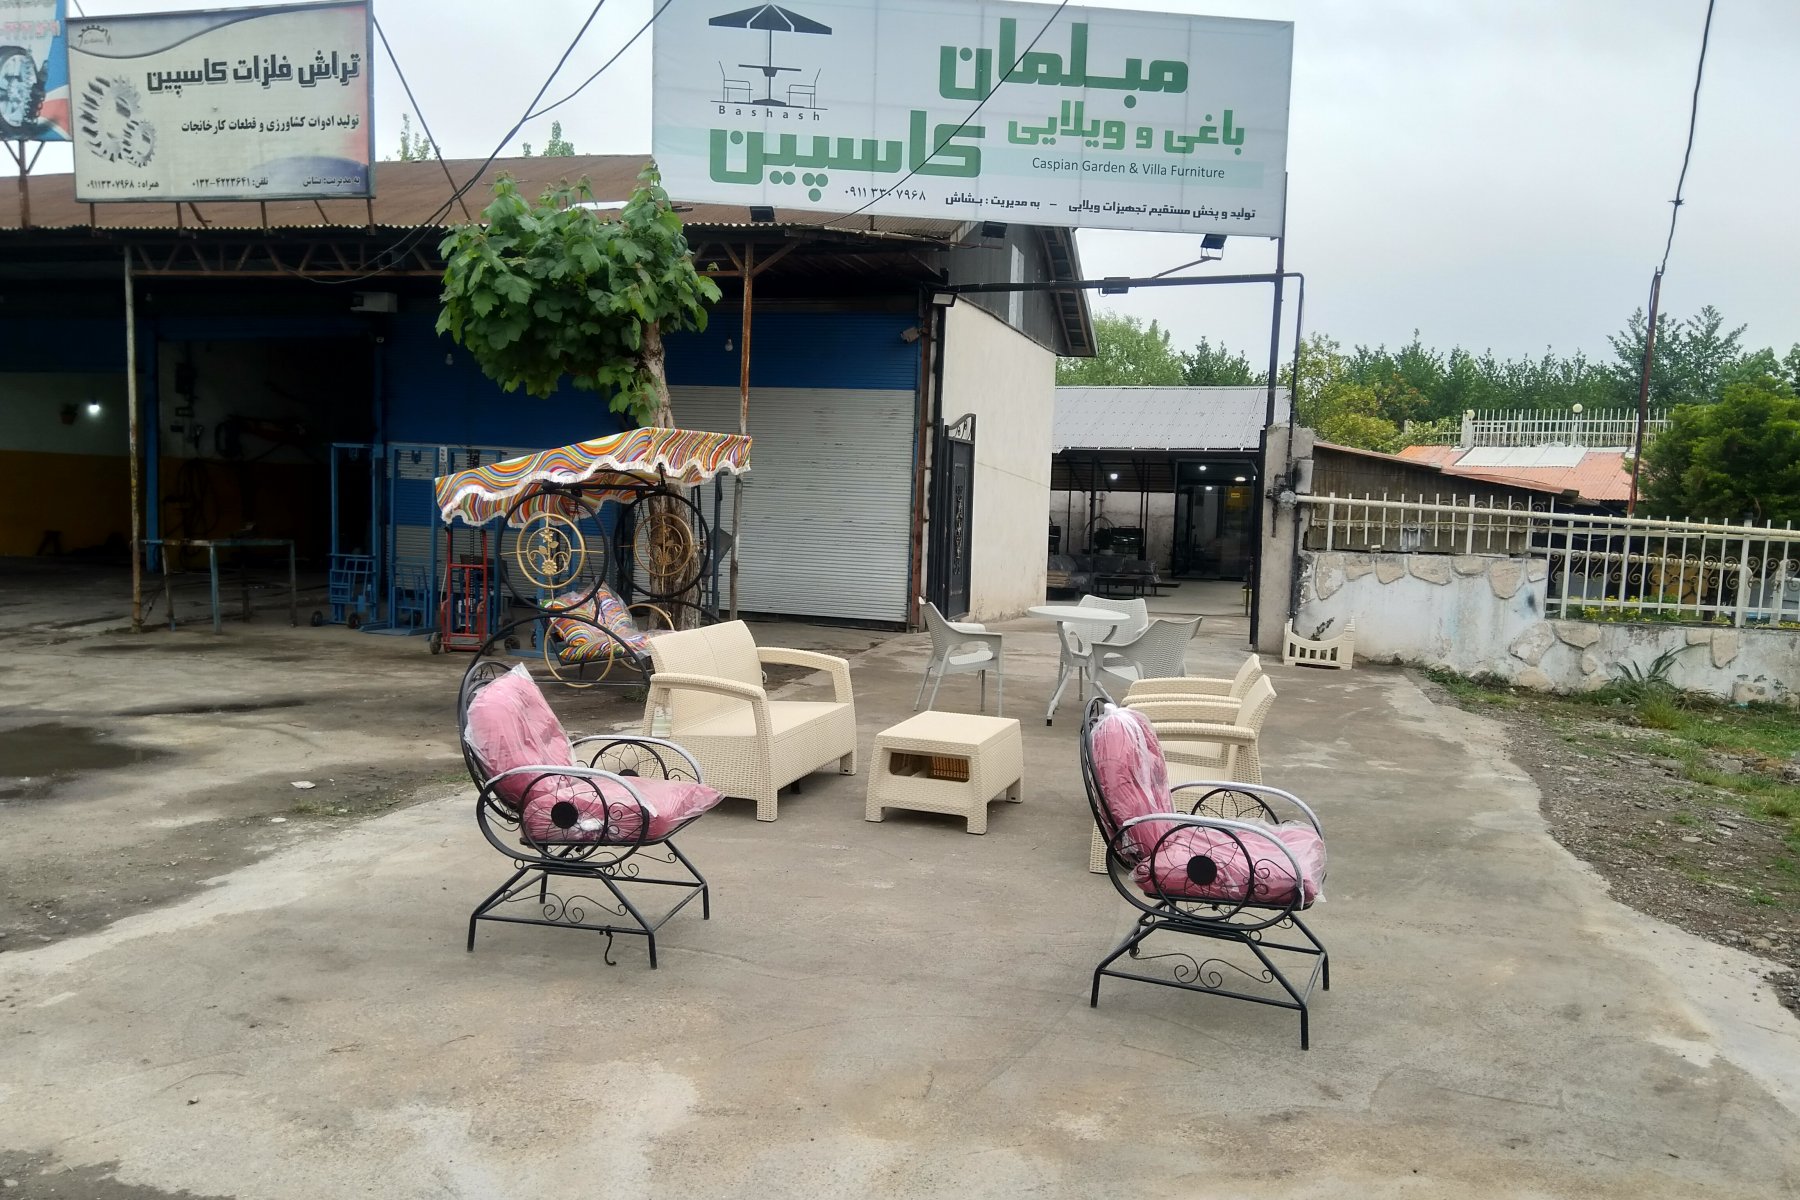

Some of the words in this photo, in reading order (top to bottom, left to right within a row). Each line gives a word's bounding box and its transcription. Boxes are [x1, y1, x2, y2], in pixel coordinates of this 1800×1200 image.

[233, 54, 292, 88] فلزات
[298, 50, 360, 86] تراش
[939, 17, 1189, 109] مبلمان
[147, 58, 228, 96] کاسپین
[718, 105, 820, 121] Bashash
[181, 119, 227, 135] کارخانجات
[229, 117, 257, 131] قطعات
[266, 116, 305, 132] کشاورزی
[308, 115, 335, 131] ادوات
[337, 114, 360, 130] تولید
[1007, 100, 1126, 150] ویلایی
[1136, 126, 1153, 149] و
[1163, 109, 1245, 156] باغی
[709, 109, 986, 202] کاسپین
[1032, 156, 1079, 172] Caspian
[1082, 159, 1126, 174] Garden
[1129, 162, 1139, 174] &
[1142, 162, 1168, 176] Villa
[1171, 164, 1225, 179] Furniture
[1068, 199, 1101, 214] ویلایی
[1103, 201, 1147, 215] تجهیزات
[1148, 204, 1191, 216] مستقیم
[1192, 205, 1219, 221] پخش
[1230, 208, 1256, 221] تولید
[1221, 211, 1228, 220] و
